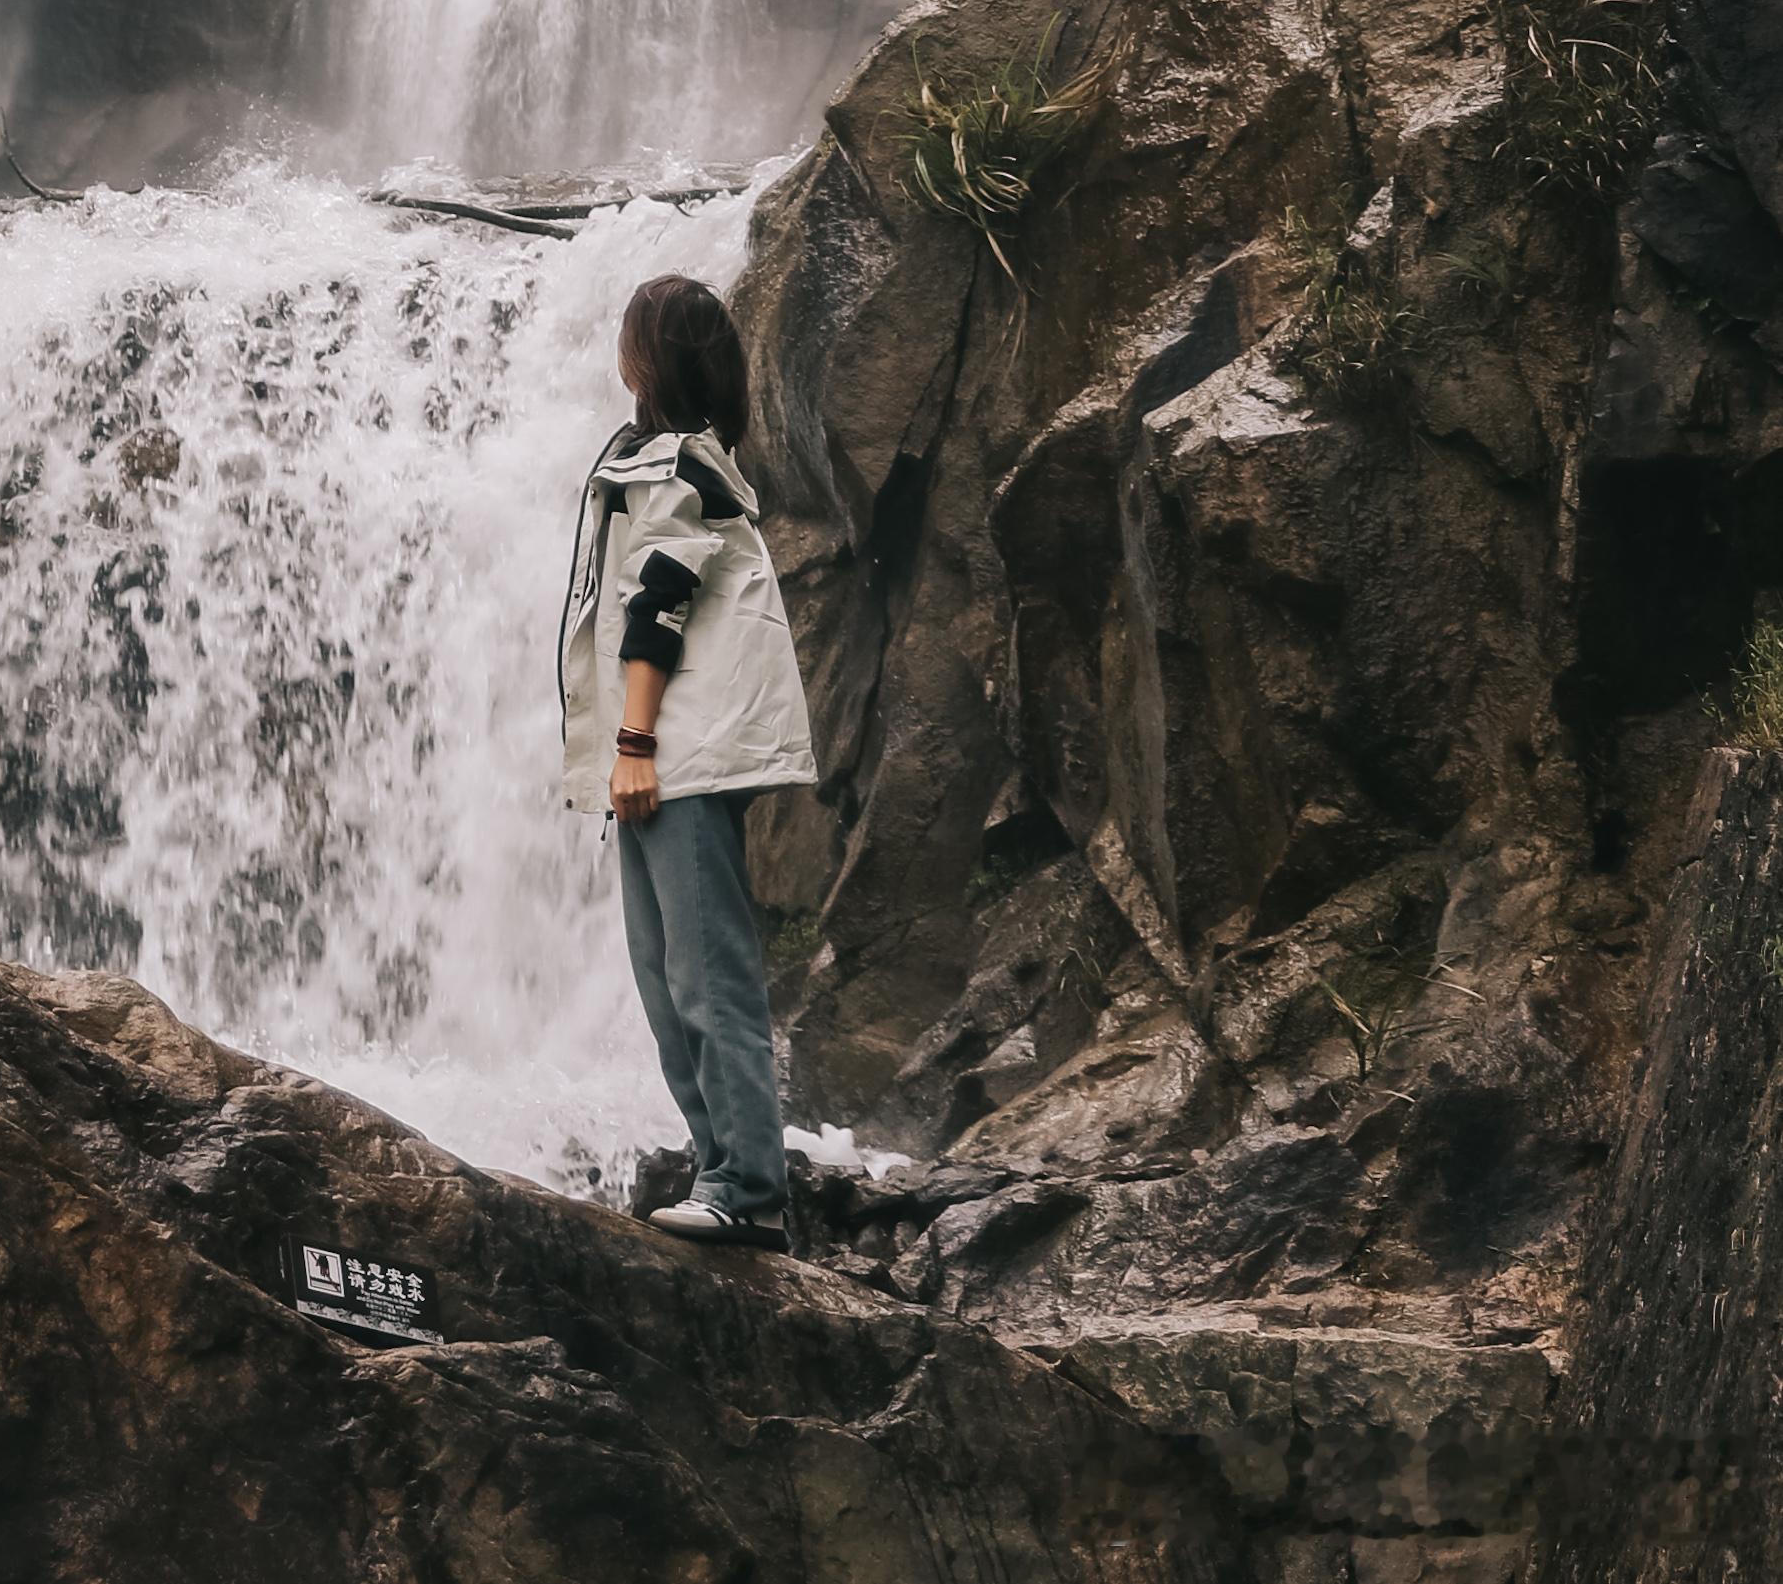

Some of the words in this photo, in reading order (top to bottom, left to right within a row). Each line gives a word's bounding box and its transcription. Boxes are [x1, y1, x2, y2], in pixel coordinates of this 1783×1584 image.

[346, 1258, 422, 1288] 注意安全
[348, 1272, 425, 1301] 请勿戏水
